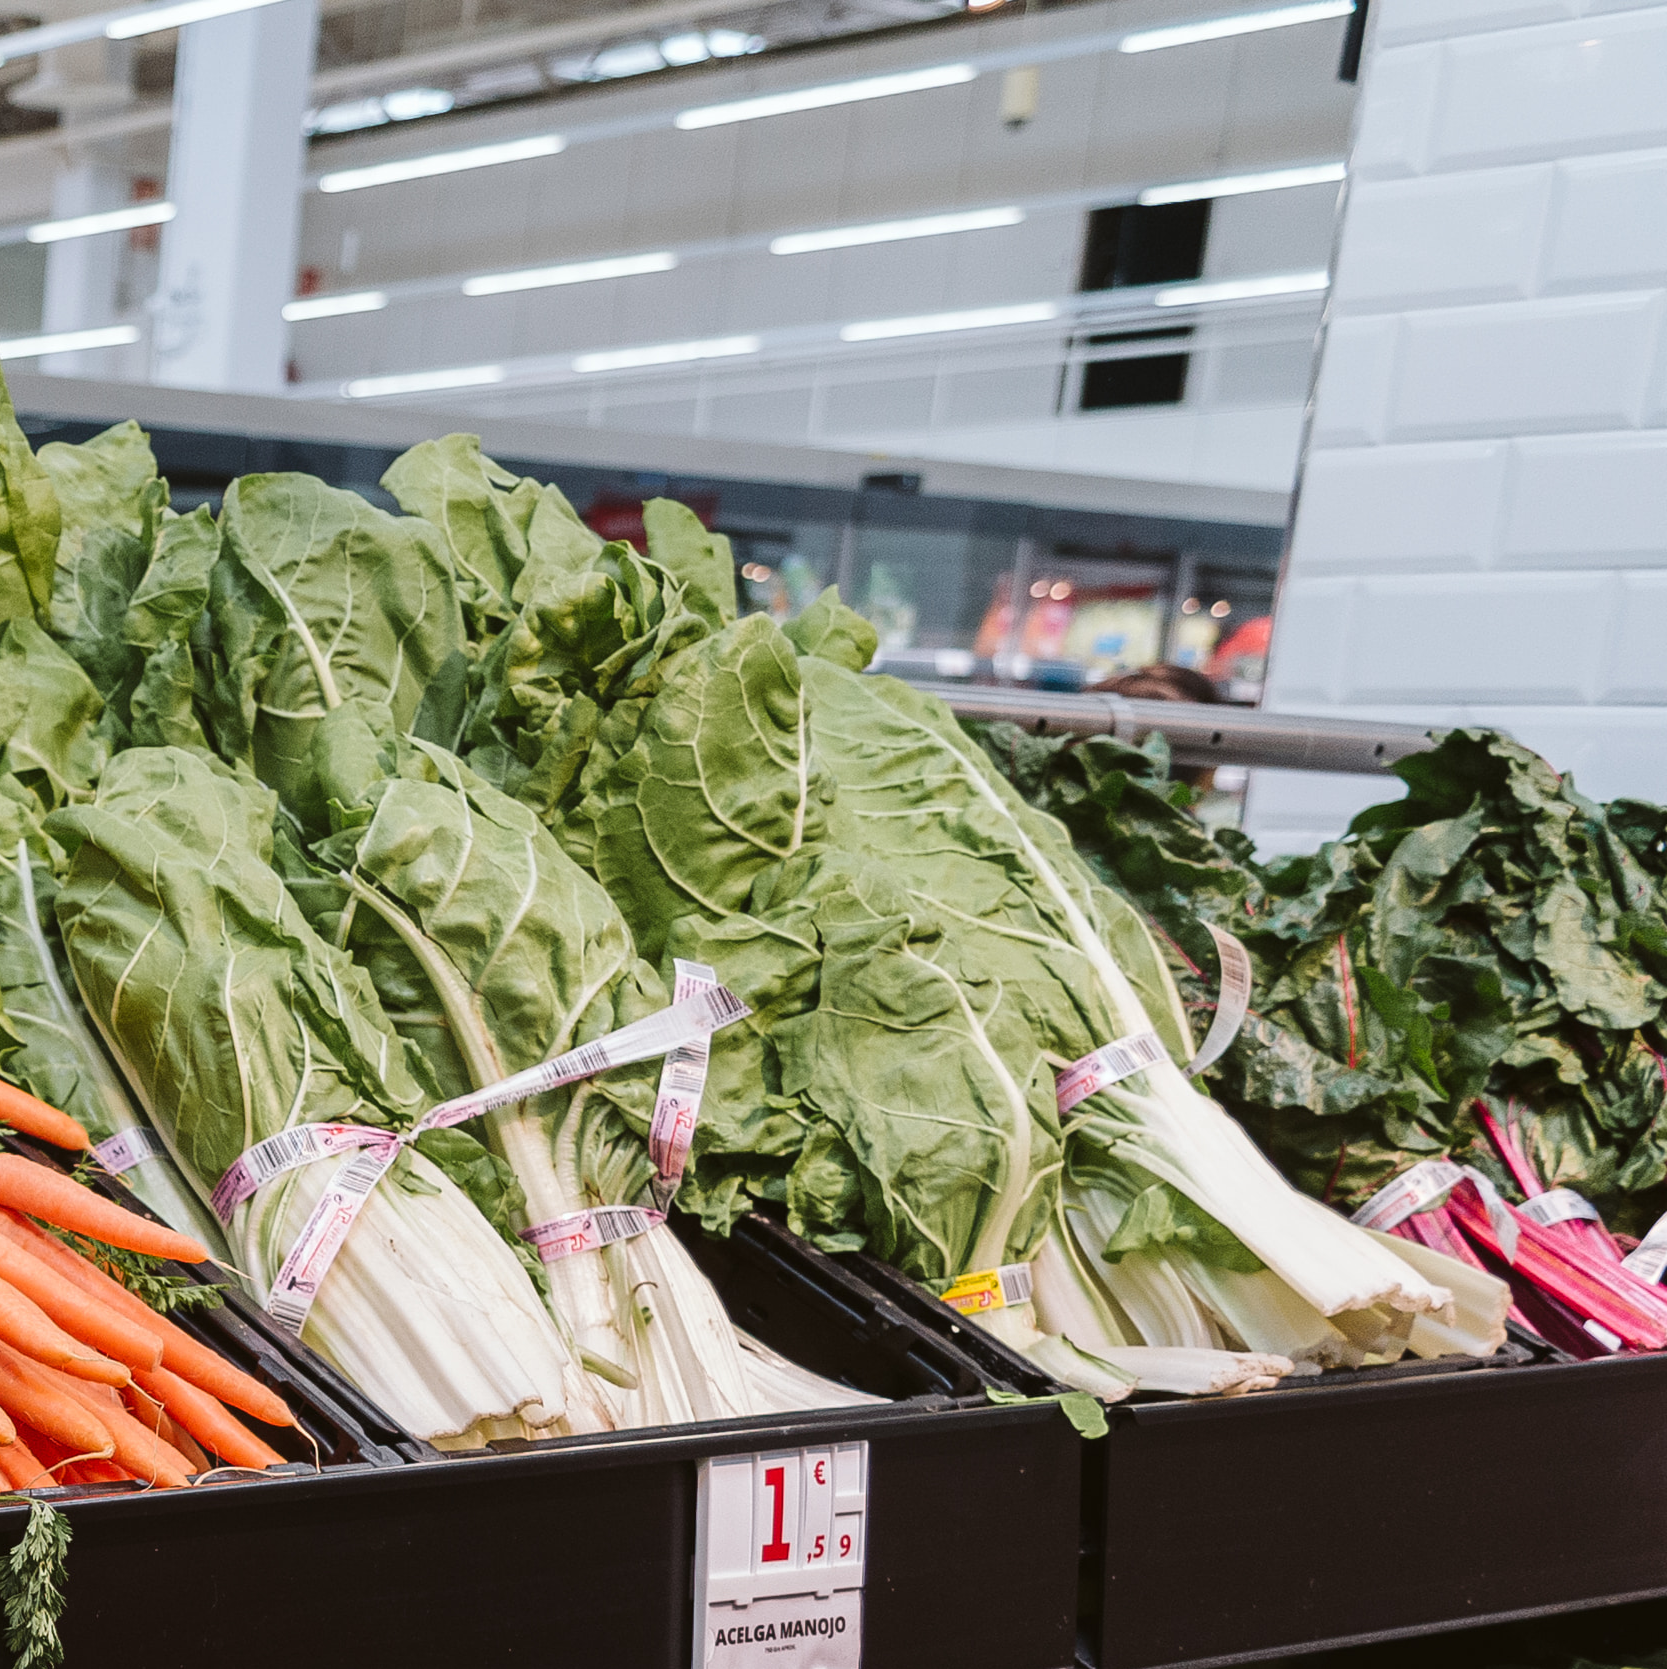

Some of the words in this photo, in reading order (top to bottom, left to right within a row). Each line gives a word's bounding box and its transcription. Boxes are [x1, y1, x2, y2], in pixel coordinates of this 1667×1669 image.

[762, 1467, 790, 1562] 1
[814, 1461, 825, 1484] €
[715, 1623, 776, 1646] ACELGA
[780, 1616, 845, 1639] MANOJO
